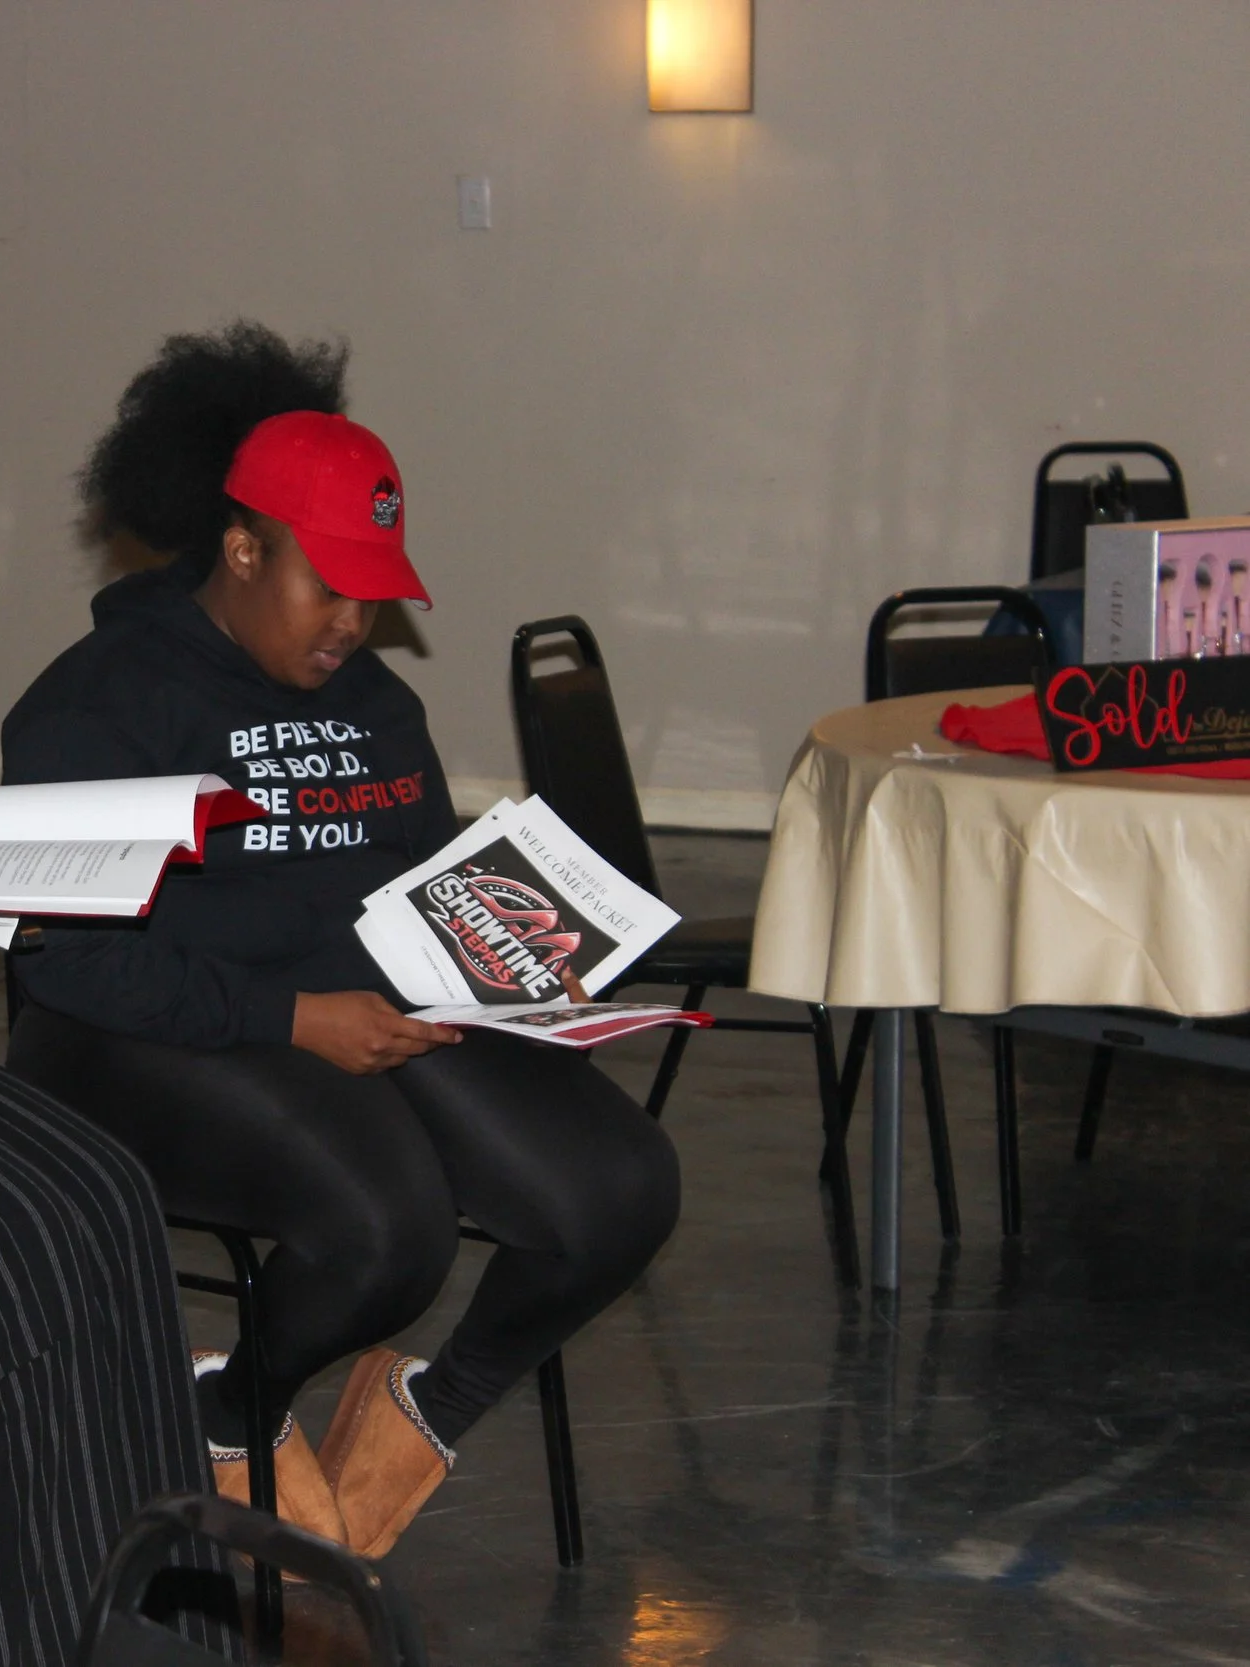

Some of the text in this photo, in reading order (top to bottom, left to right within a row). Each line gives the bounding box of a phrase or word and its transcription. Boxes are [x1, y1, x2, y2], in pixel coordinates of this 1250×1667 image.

[1046, 664, 1193, 766] Sold
[230, 724, 269, 758] BE
[243, 758, 287, 778] BE
[248, 787, 291, 815] BE
[243, 820, 370, 851] BE YOU.
[518, 825, 638, 933] WELCOME PACKET
[567, 856, 609, 896] MEMBER
[432, 876, 561, 999] SHOWTIME
[445, 917, 515, 983] STEPPAS
